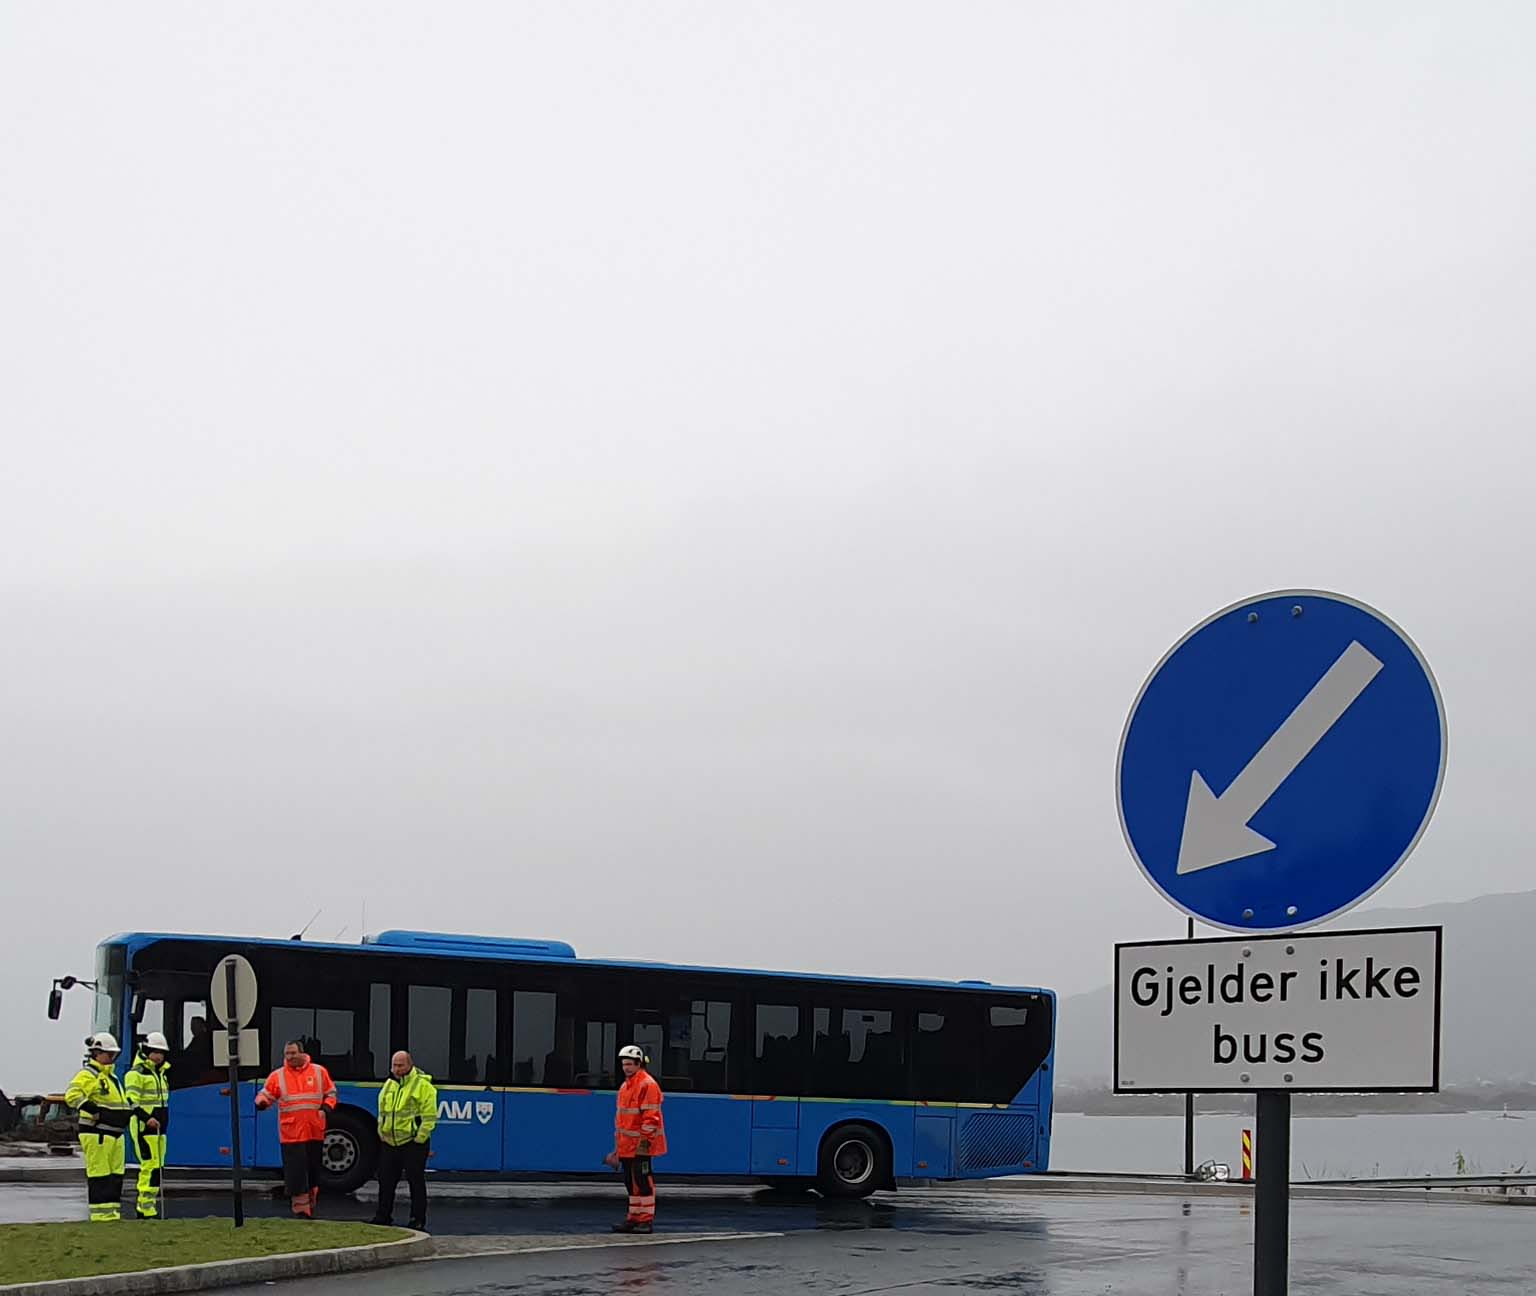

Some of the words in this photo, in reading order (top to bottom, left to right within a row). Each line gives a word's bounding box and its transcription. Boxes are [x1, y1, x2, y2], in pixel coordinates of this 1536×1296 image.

[1130, 963, 1298, 1017] Gjelder
[1319, 957, 1421, 1001] ikke
[1213, 1023, 1325, 1064] buss
